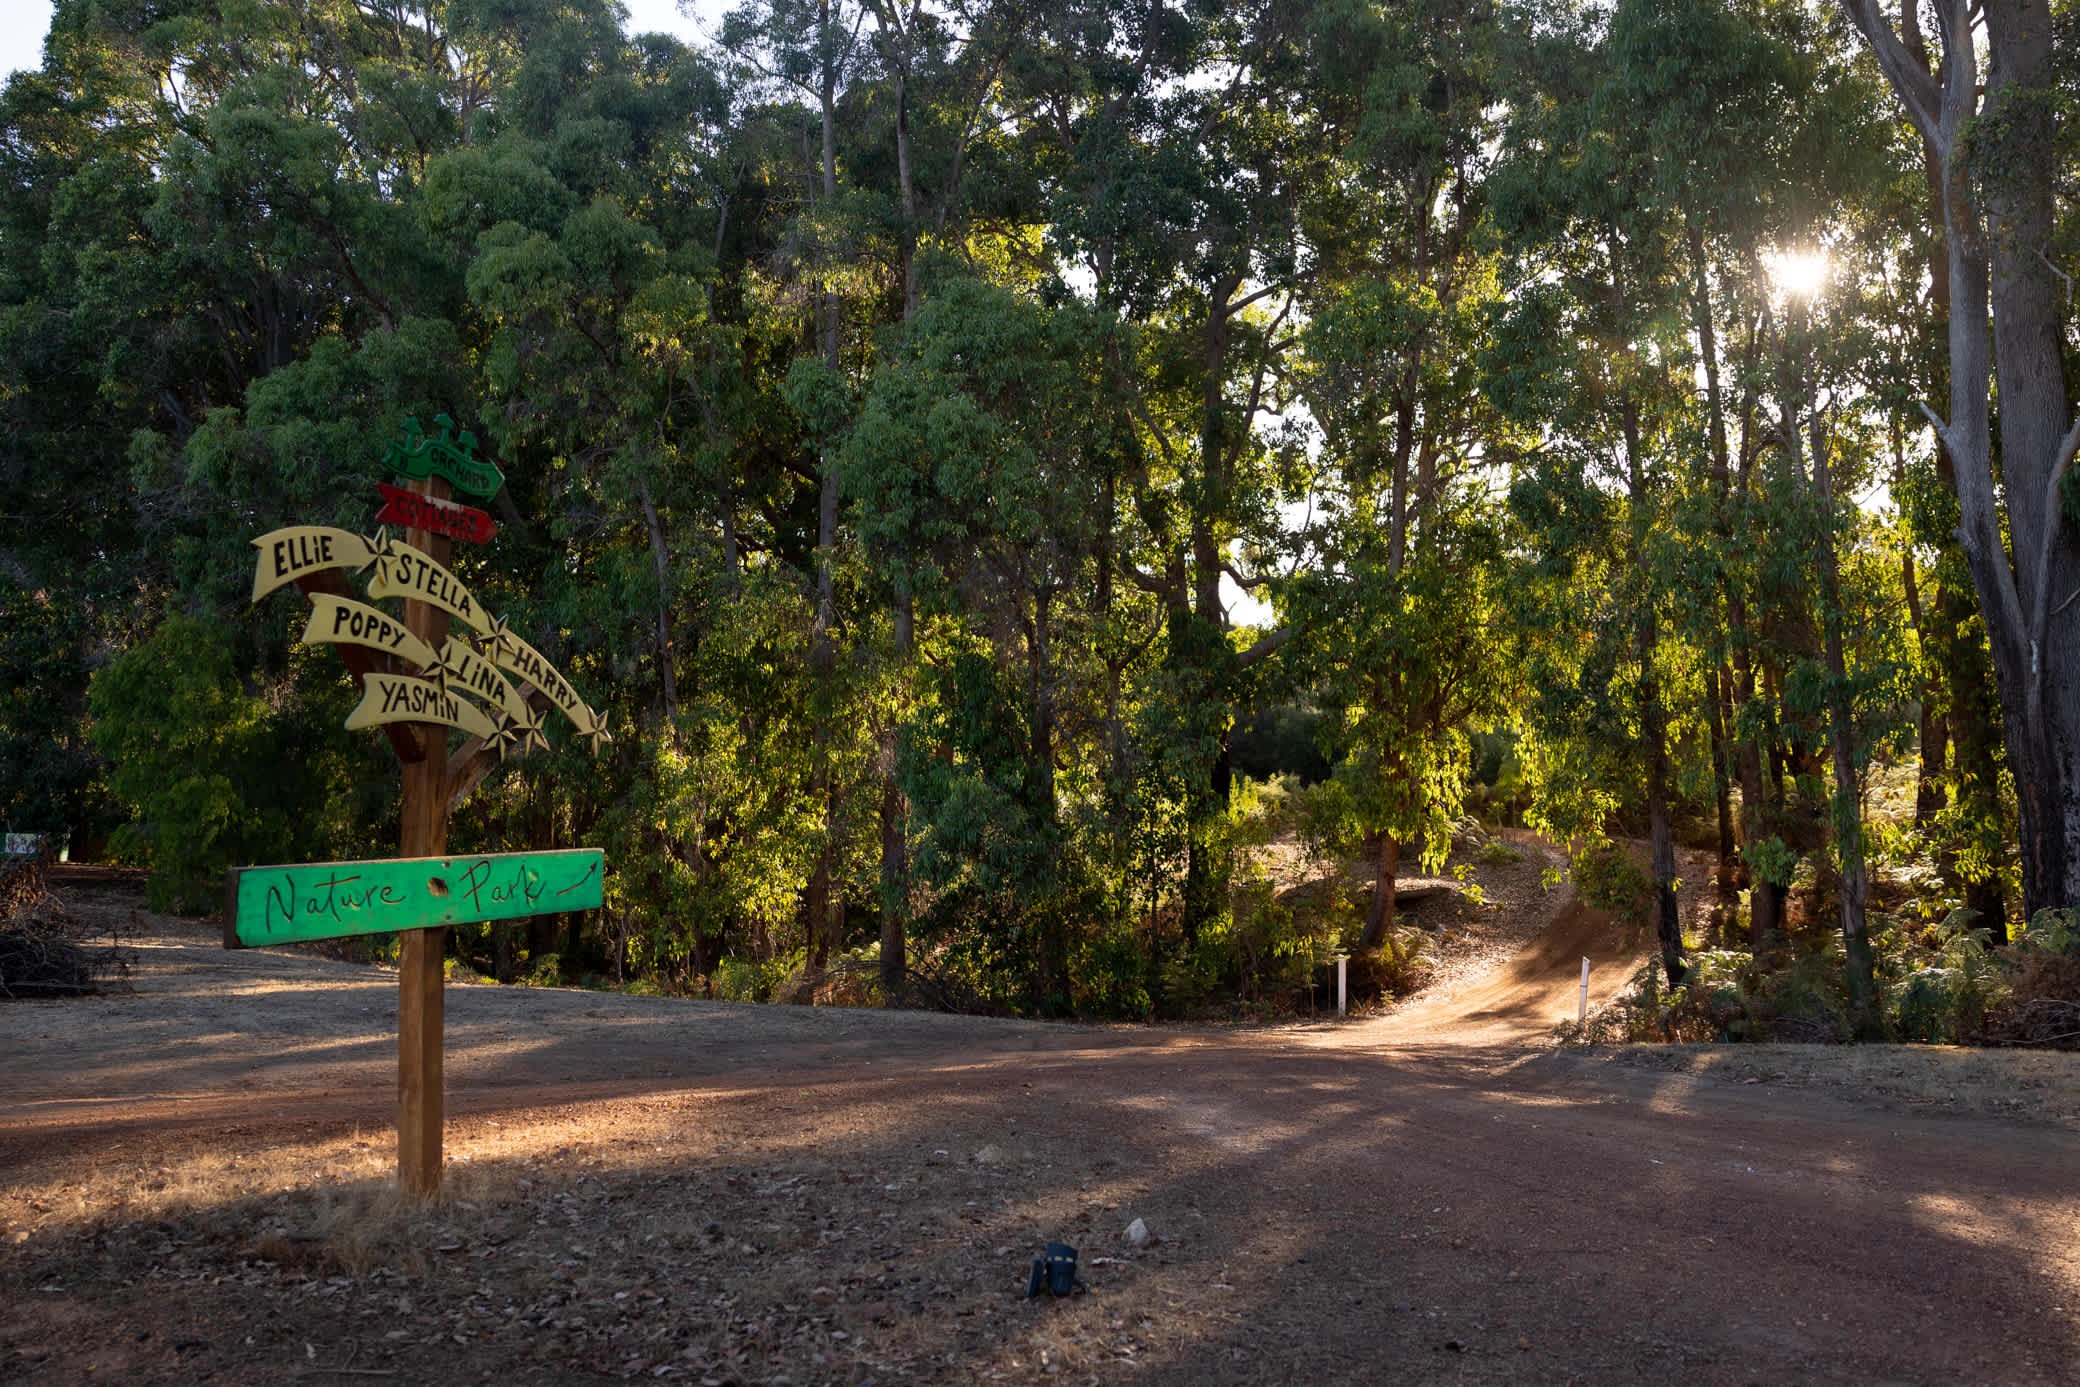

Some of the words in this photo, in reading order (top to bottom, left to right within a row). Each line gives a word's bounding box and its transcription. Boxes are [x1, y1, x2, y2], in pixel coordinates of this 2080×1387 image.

[431, 447, 489, 489] ORCHARD
[395, 496, 477, 535] COTTAGES
[396, 553, 471, 618] STELLA
[333, 606, 406, 648] POPPY
[513, 646, 577, 710] HARRY
[266, 873, 406, 933] Nature
[459, 860, 546, 913] Park
